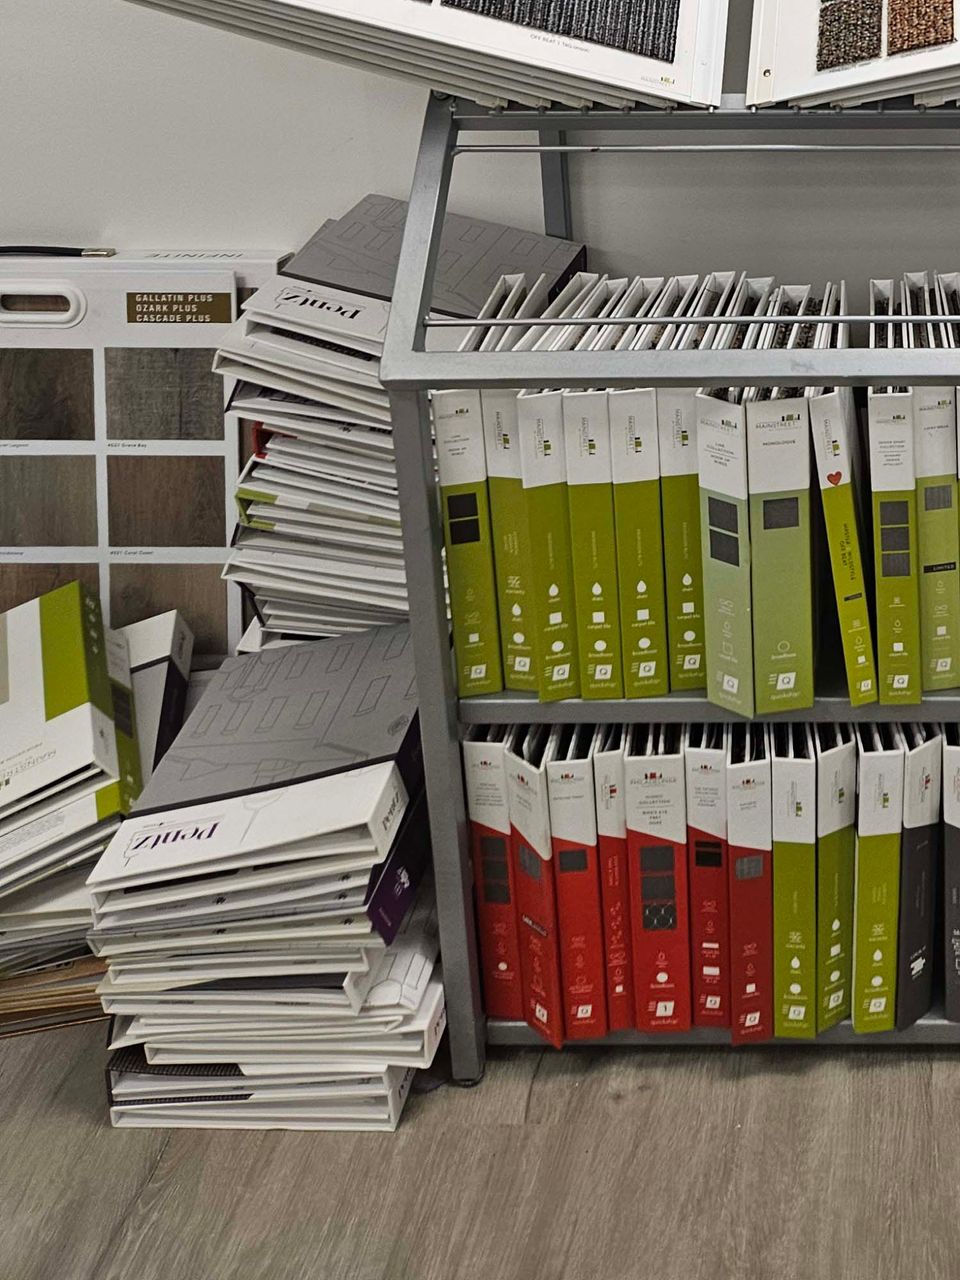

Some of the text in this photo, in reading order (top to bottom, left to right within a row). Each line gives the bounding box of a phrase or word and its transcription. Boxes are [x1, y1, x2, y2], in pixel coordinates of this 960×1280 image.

[145, 251, 244, 261] INFINITE
[135, 294, 213, 303] GALLATIN PLUS
[135, 304, 199, 313] OZARK PLUS
[136, 314, 212, 323] CASCADE PLUS
